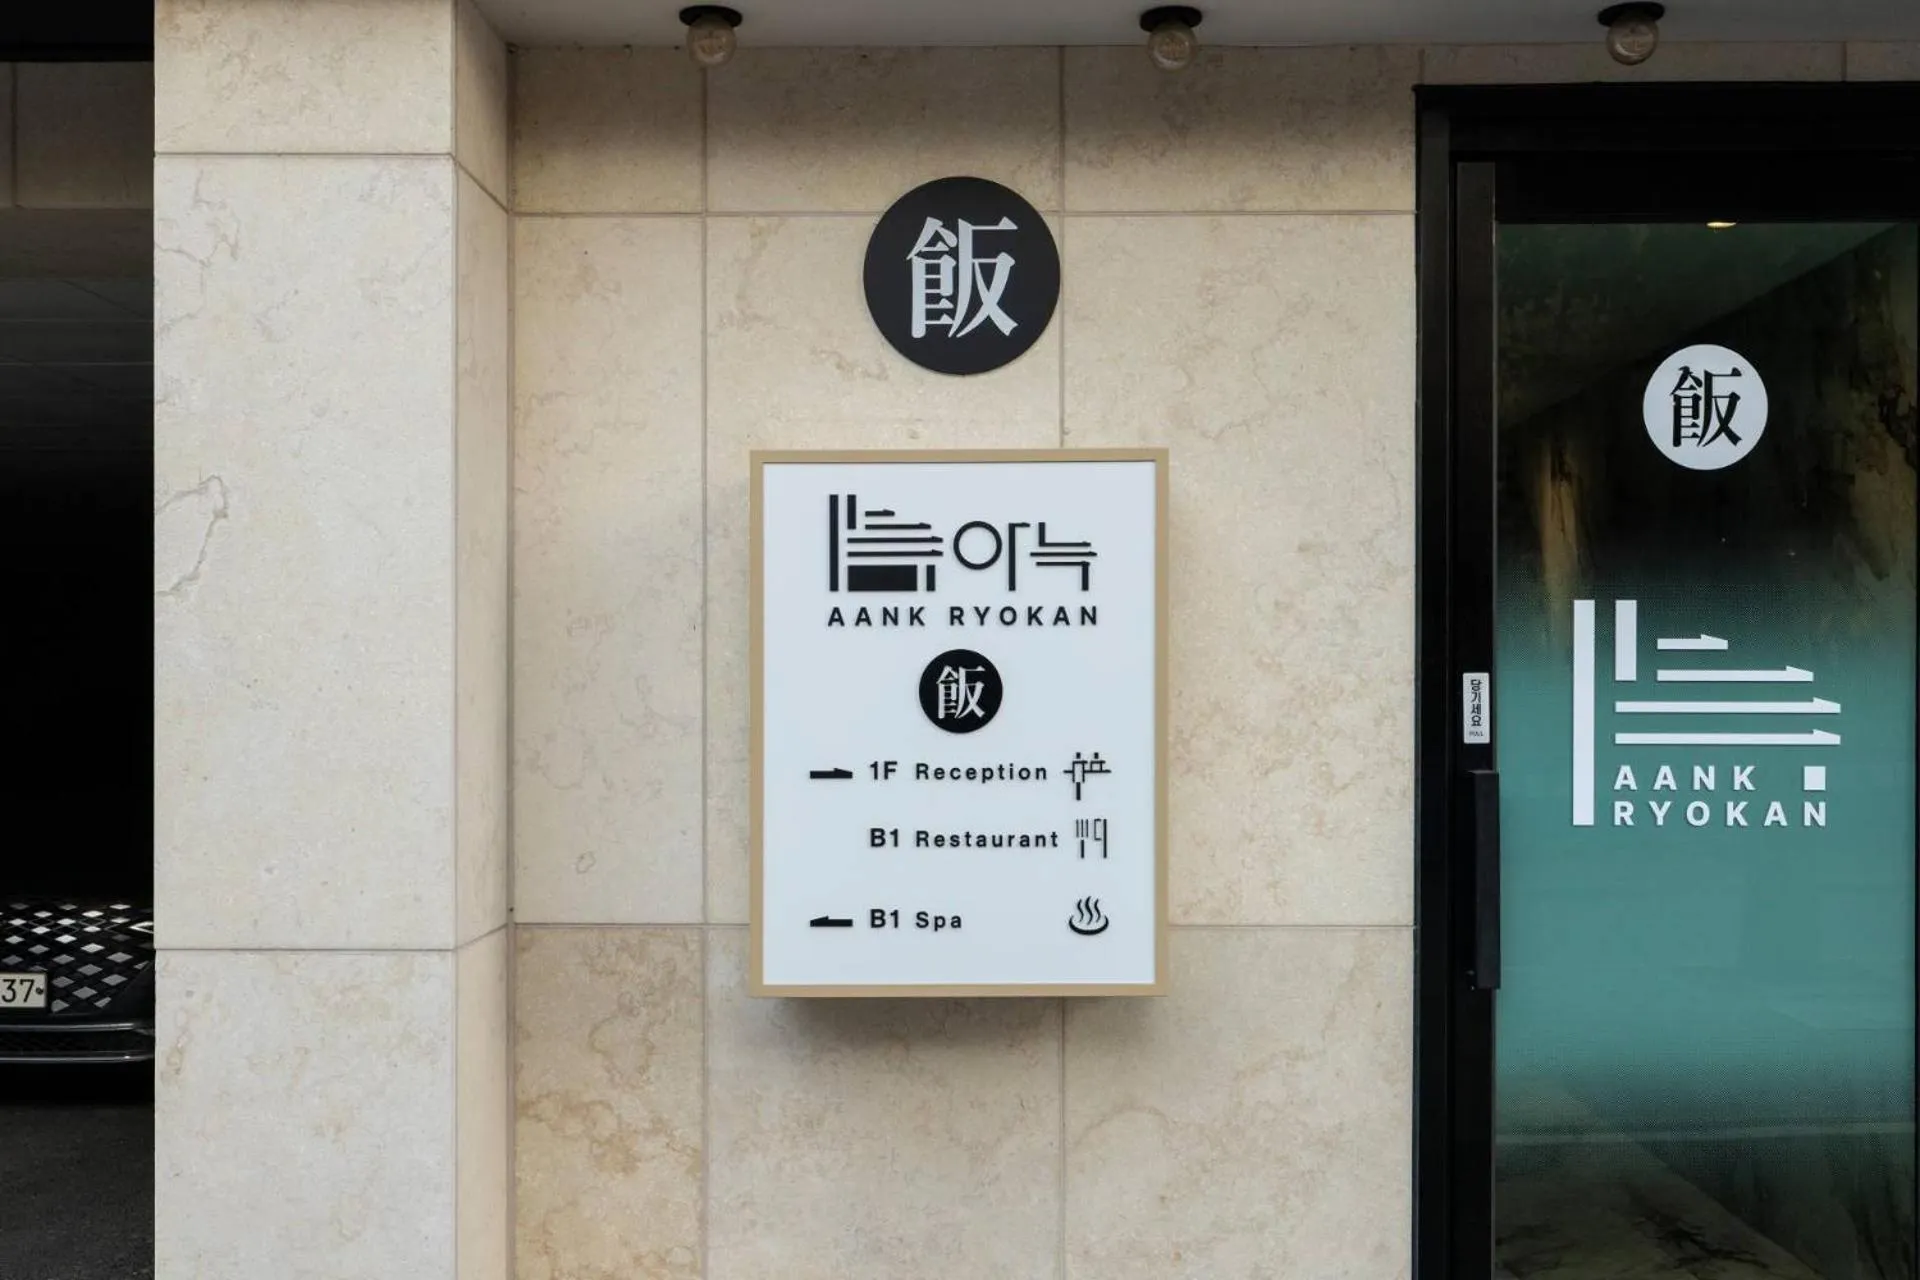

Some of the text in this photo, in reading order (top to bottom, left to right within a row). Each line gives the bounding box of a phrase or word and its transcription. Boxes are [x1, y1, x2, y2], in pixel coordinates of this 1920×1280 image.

[907, 216, 1018, 339] 飯
[1670, 365, 1743, 448] 飯
[827, 605, 1097, 627] AANK RYOKAN
[936, 665, 986, 720] 飯
[1470, 678, 1483, 727] 당기세요
[869, 760, 1047, 784] 1F Reception
[1613, 765, 1756, 791] AANK
[1613, 800, 1826, 827] RYOKAN
[870, 827, 1058, 849] B1 Restaurant
[870, 908, 962, 932] B1 Spa
[1, 978, 35, 1003] 37
